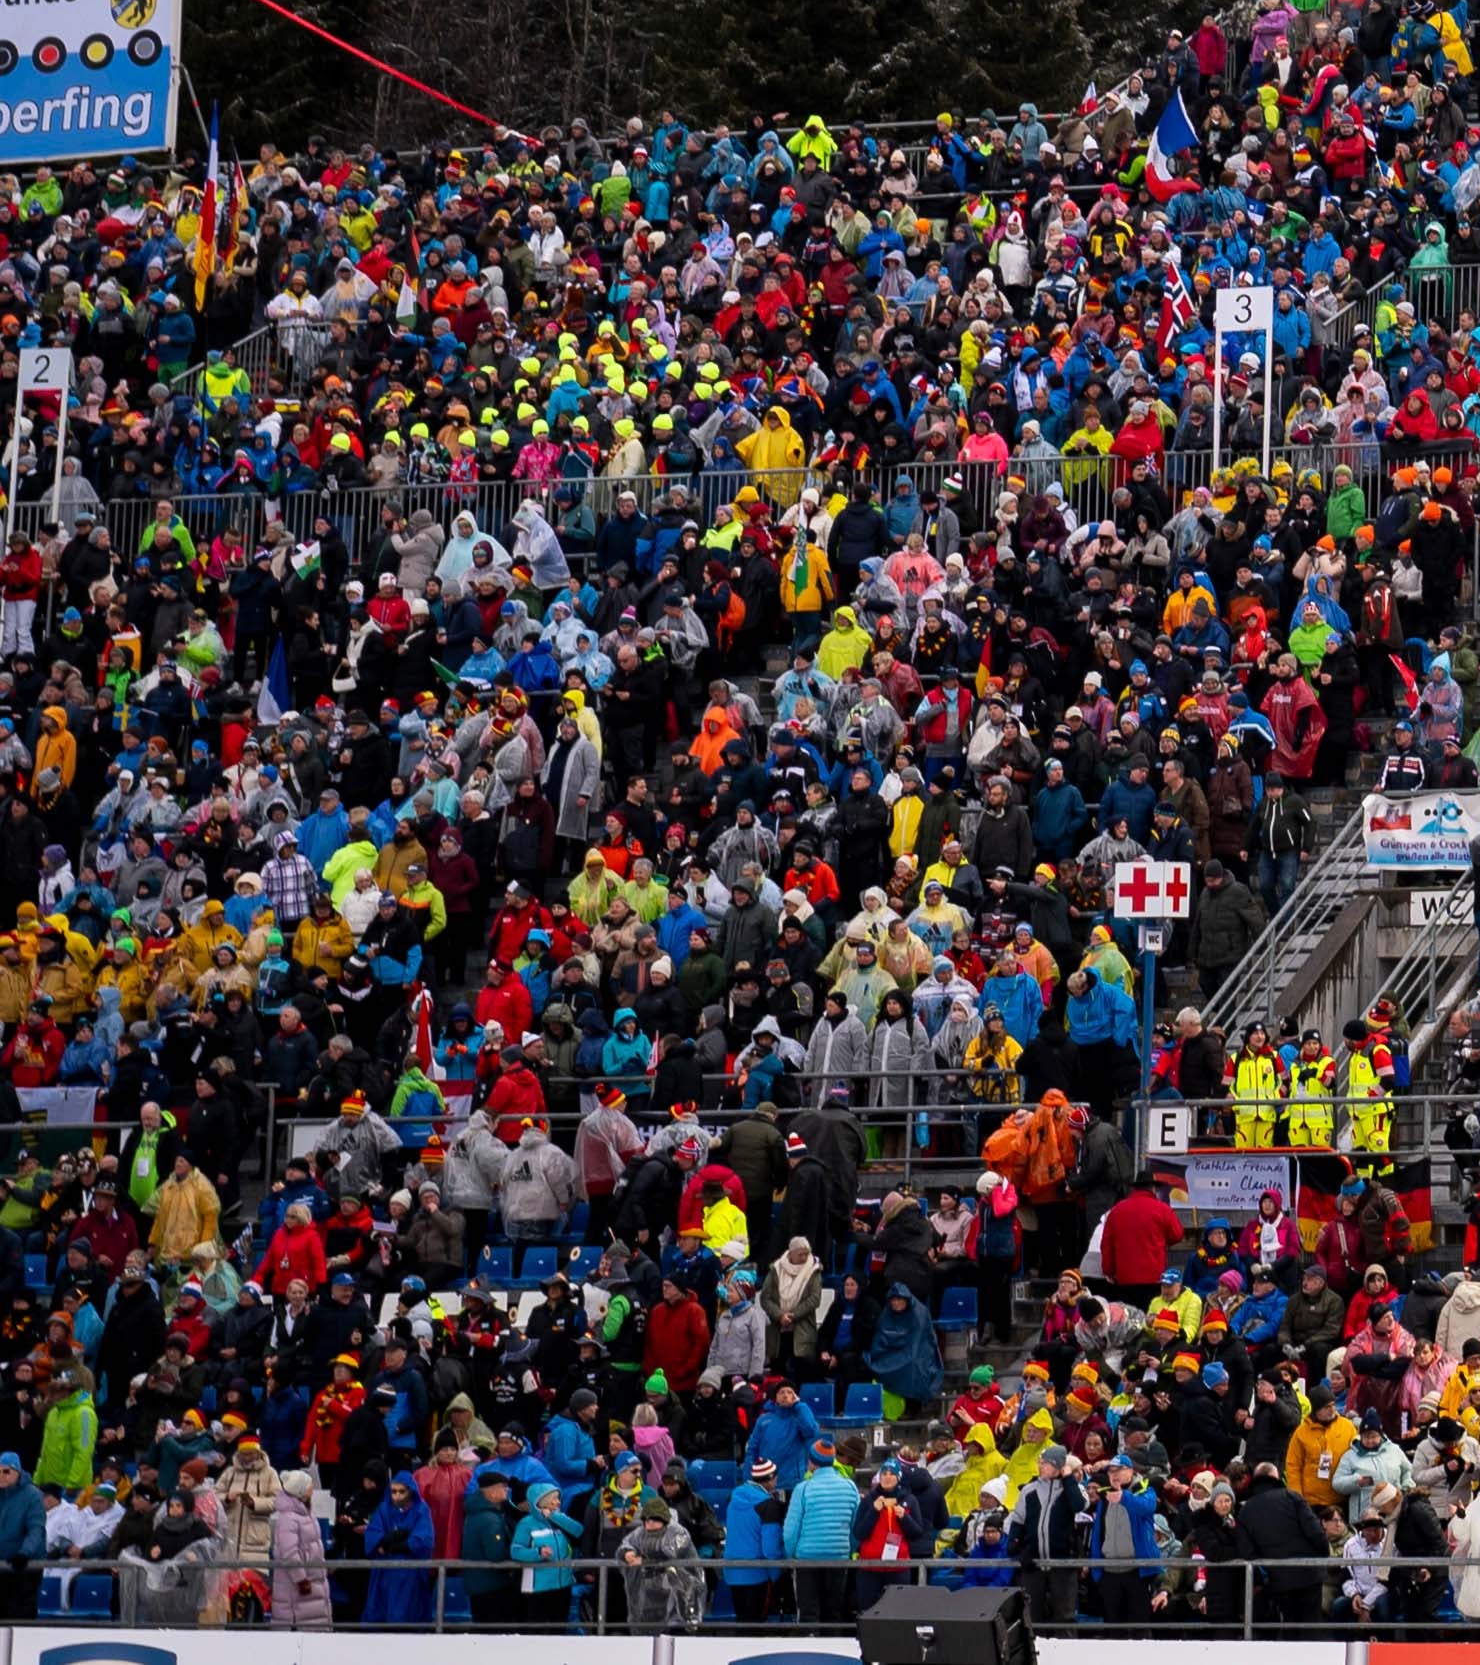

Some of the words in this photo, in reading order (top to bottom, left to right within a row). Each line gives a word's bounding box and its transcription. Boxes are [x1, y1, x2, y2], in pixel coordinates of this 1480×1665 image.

[1234, 294, 1252, 324] 3
[33, 354, 50, 383] 2
[1421, 896, 1465, 921] WC
[1147, 934, 1160, 944] WC
[1160, 1112, 1177, 1147] E
